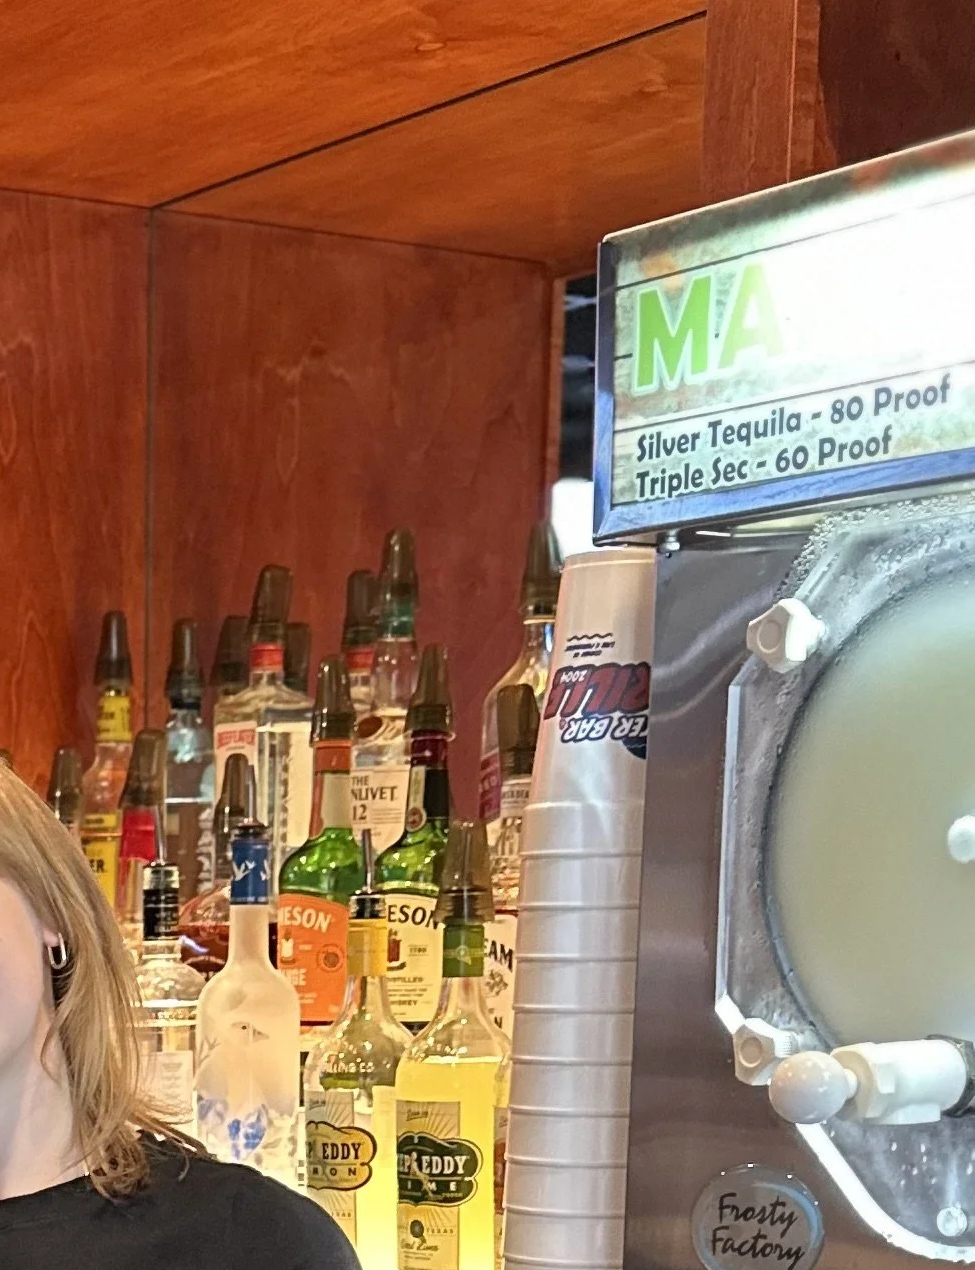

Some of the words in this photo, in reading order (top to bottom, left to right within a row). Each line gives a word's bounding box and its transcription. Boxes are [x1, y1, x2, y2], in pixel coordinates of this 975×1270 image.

[636, 430, 700, 463] Silver
[708, 407, 801, 449] Tequila
[830, 396, 864, 424] 80
[874, 374, 951, 416] Proof
[636, 462, 703, 498] Triple
[711, 458, 748, 485] Sec
[775, 445, 809, 473] 60
[818, 425, 892, 465] Proof
[560, 670, 587, 683] 2004
[562, 717, 610, 741] BAR
[322, 1143, 362, 1160] EDDY
[421, 1155, 466, 1174] EDDY
[718, 1192, 798, 1239] Frosty
